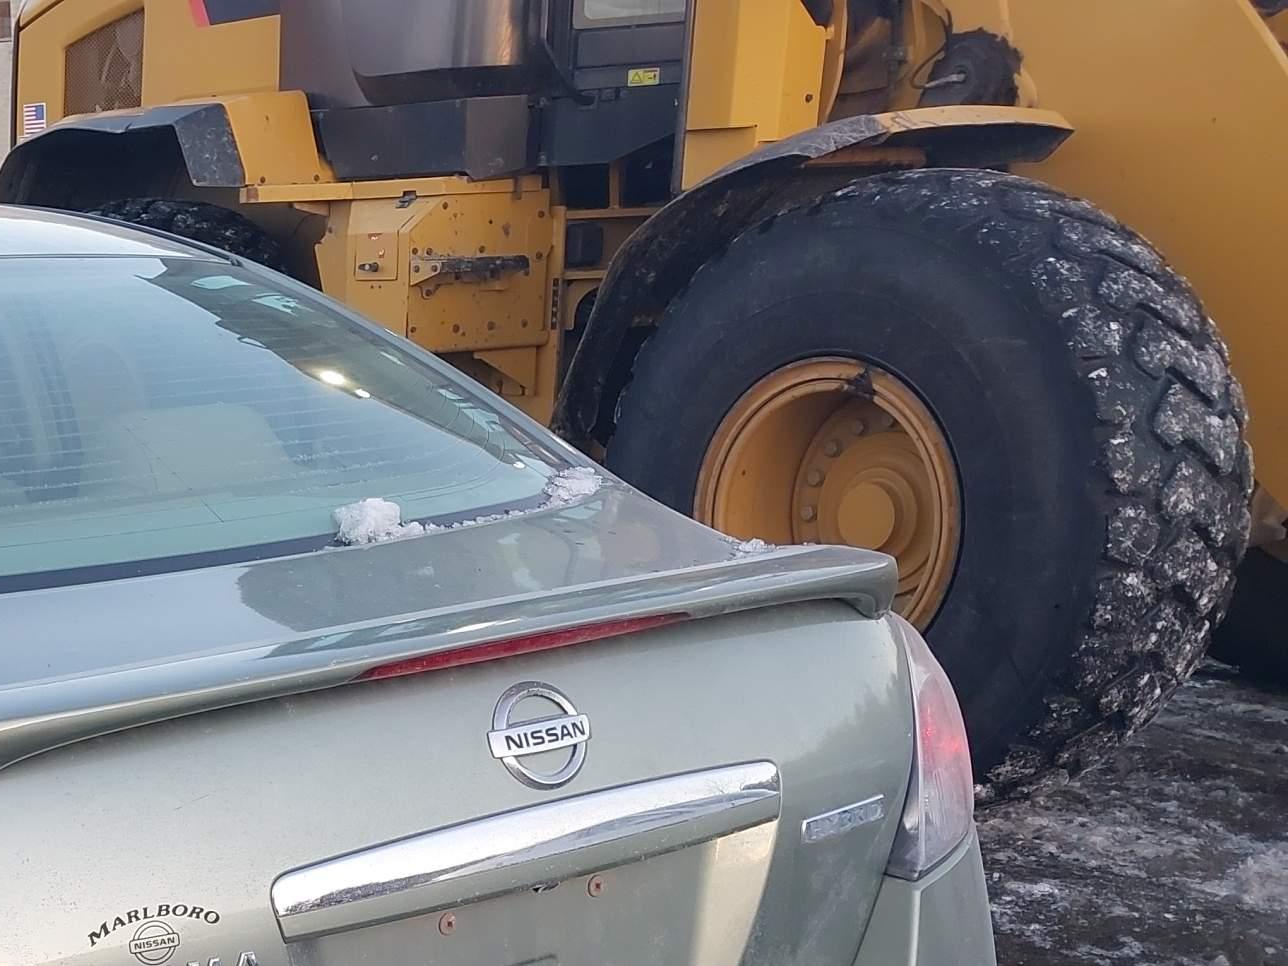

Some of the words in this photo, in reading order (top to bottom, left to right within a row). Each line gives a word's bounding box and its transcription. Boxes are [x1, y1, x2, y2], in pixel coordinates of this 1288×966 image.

[504, 720, 586, 751] NISSAN
[87, 904, 221, 948] MARLBORO
[133, 937, 176, 951] NISSAN
